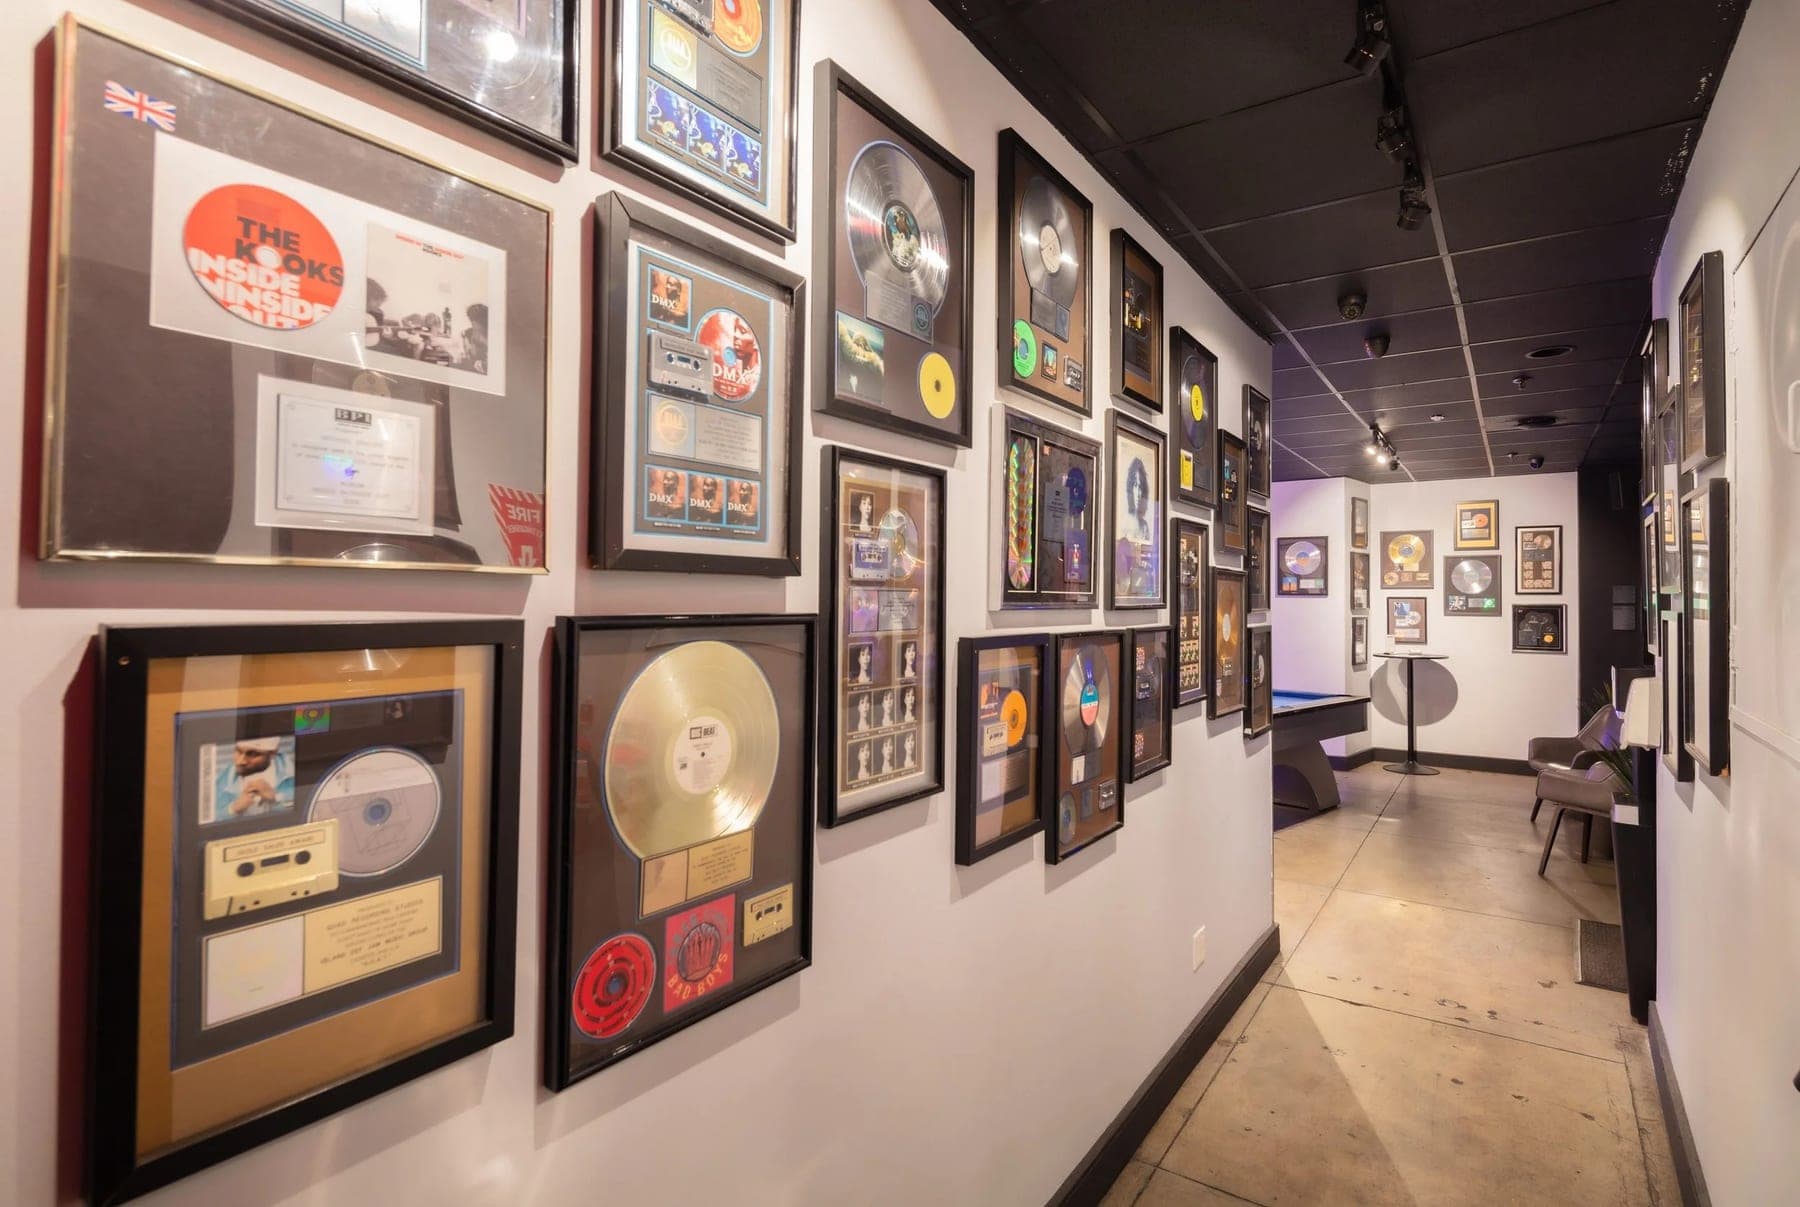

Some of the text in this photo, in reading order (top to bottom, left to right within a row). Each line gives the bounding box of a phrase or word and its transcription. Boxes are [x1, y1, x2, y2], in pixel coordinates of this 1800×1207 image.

[237, 216, 300, 253] THE
[235, 238, 344, 287] KOKS
[188, 247, 300, 297] INSIDE
[652, 294, 676, 309] DMX
[712, 364, 747, 385] DMX
[336, 408, 371, 424] BPI
[649, 492, 673, 504] DMX
[690, 498, 713, 509] DMX
[728, 502, 748, 512] DMX
[667, 953, 728, 1000] BAD BOYS
